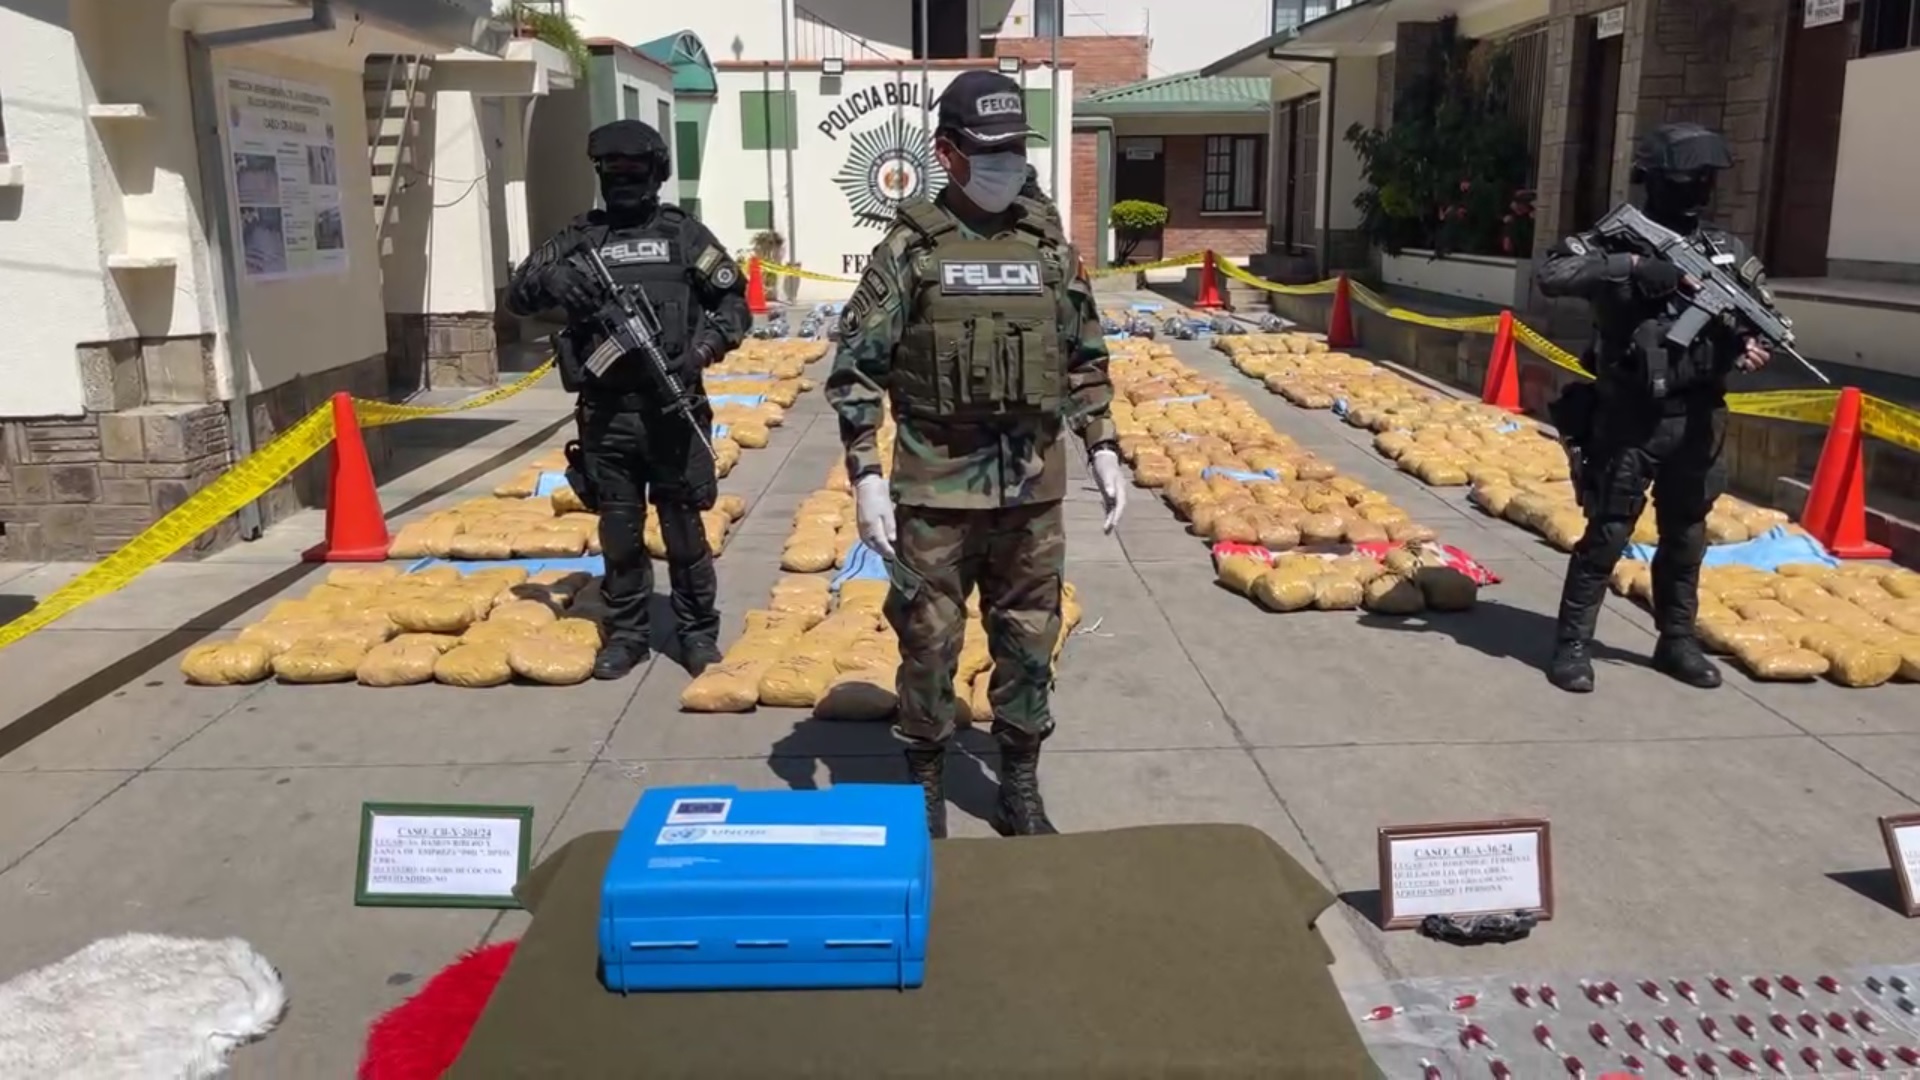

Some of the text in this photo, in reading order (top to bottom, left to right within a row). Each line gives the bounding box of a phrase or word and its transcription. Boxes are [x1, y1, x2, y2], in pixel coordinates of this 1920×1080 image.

[817, 86, 884, 141] POLICIA
[601, 242, 667, 260] FELCN
[943, 263, 1041, 285] FELCN
